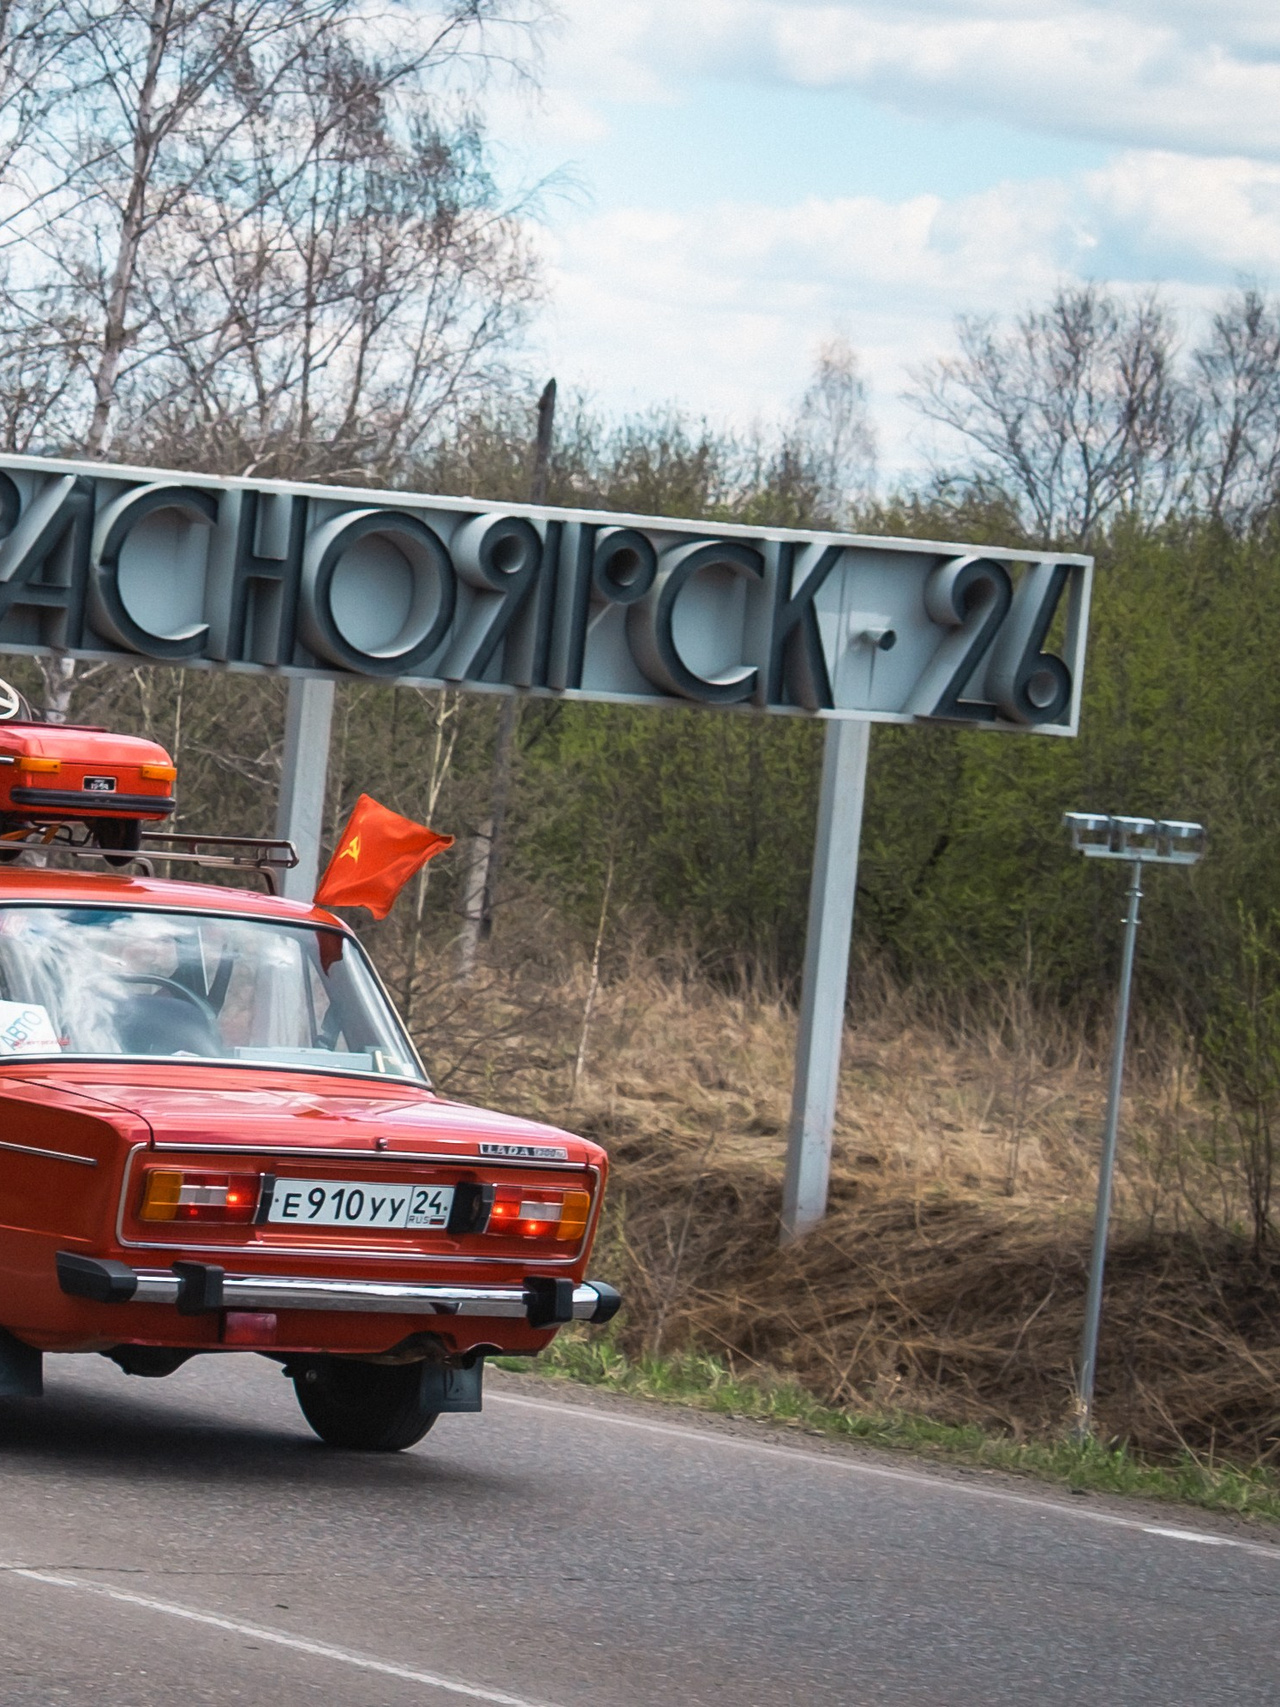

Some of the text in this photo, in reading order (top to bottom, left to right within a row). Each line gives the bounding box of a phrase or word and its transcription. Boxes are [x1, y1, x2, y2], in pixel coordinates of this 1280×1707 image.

[487, 1144, 530, 1156] LADA
[413, 1190, 443, 1215] 24
[408, 1215, 429, 1224] RUS
